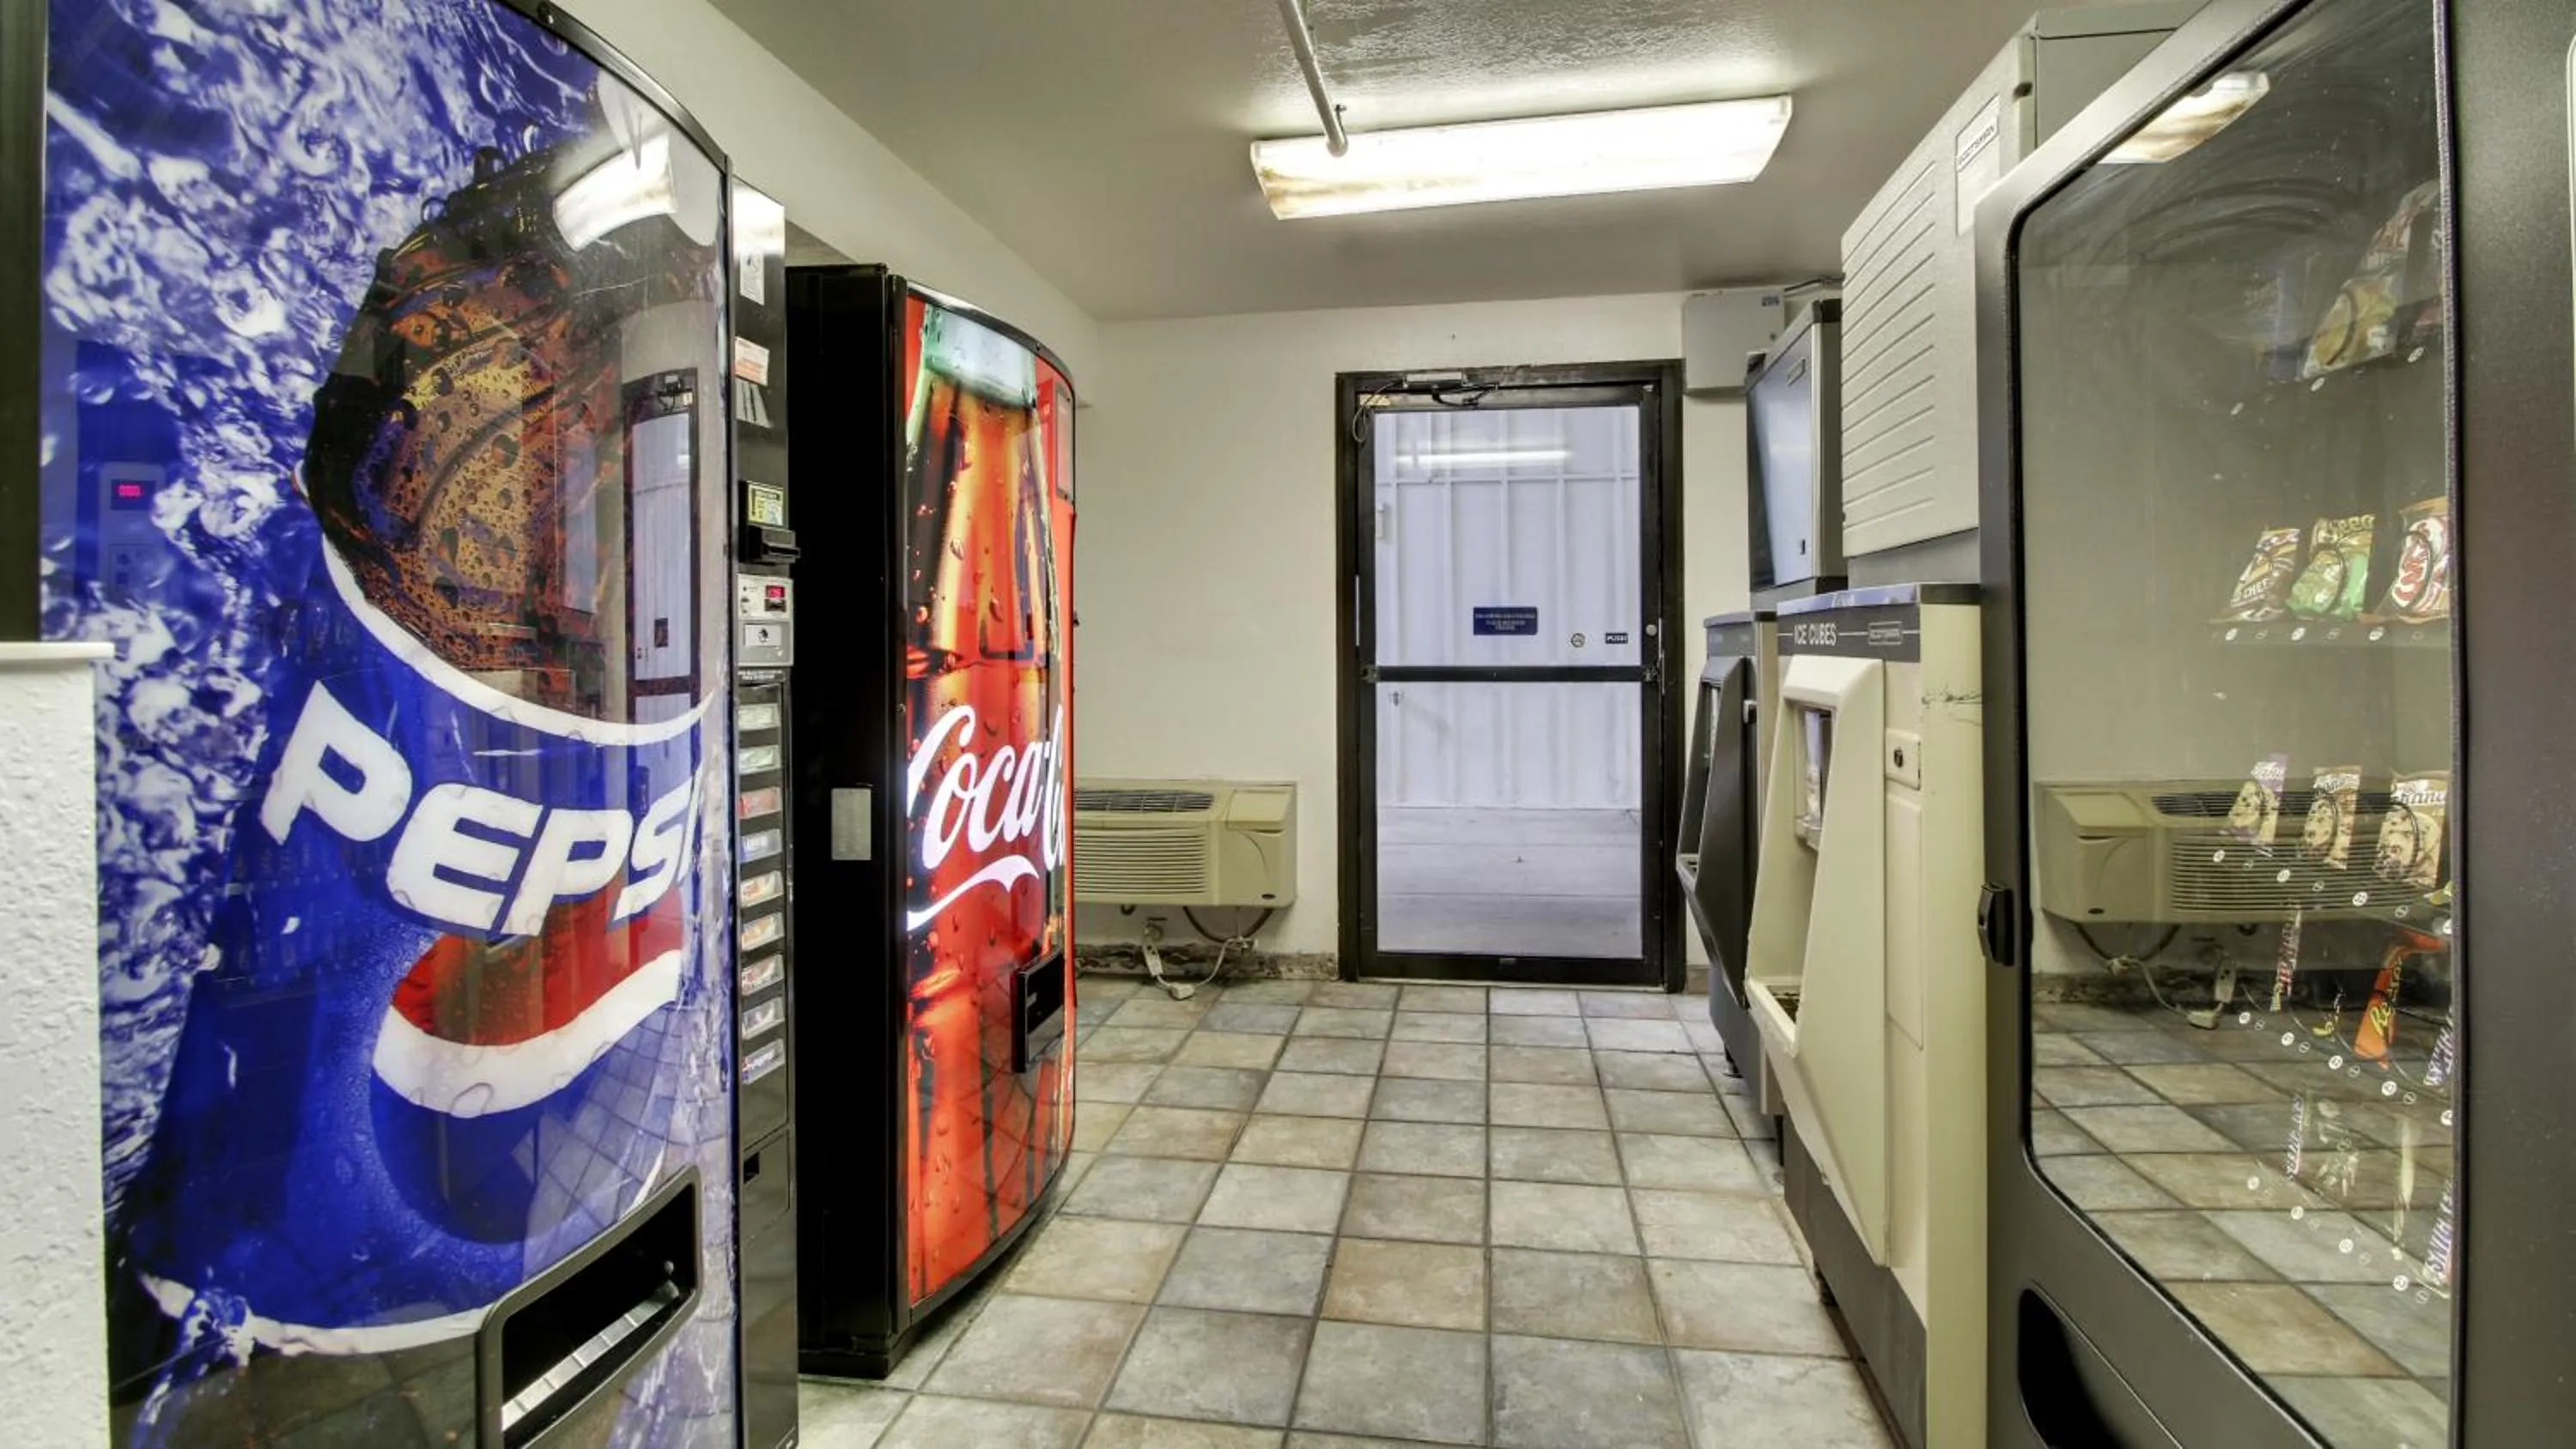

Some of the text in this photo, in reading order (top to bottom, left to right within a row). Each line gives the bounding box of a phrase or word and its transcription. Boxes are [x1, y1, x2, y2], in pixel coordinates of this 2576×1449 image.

[1794, 622, 1837, 646] ICE CUBES
[261, 679, 704, 937] PEPSI
